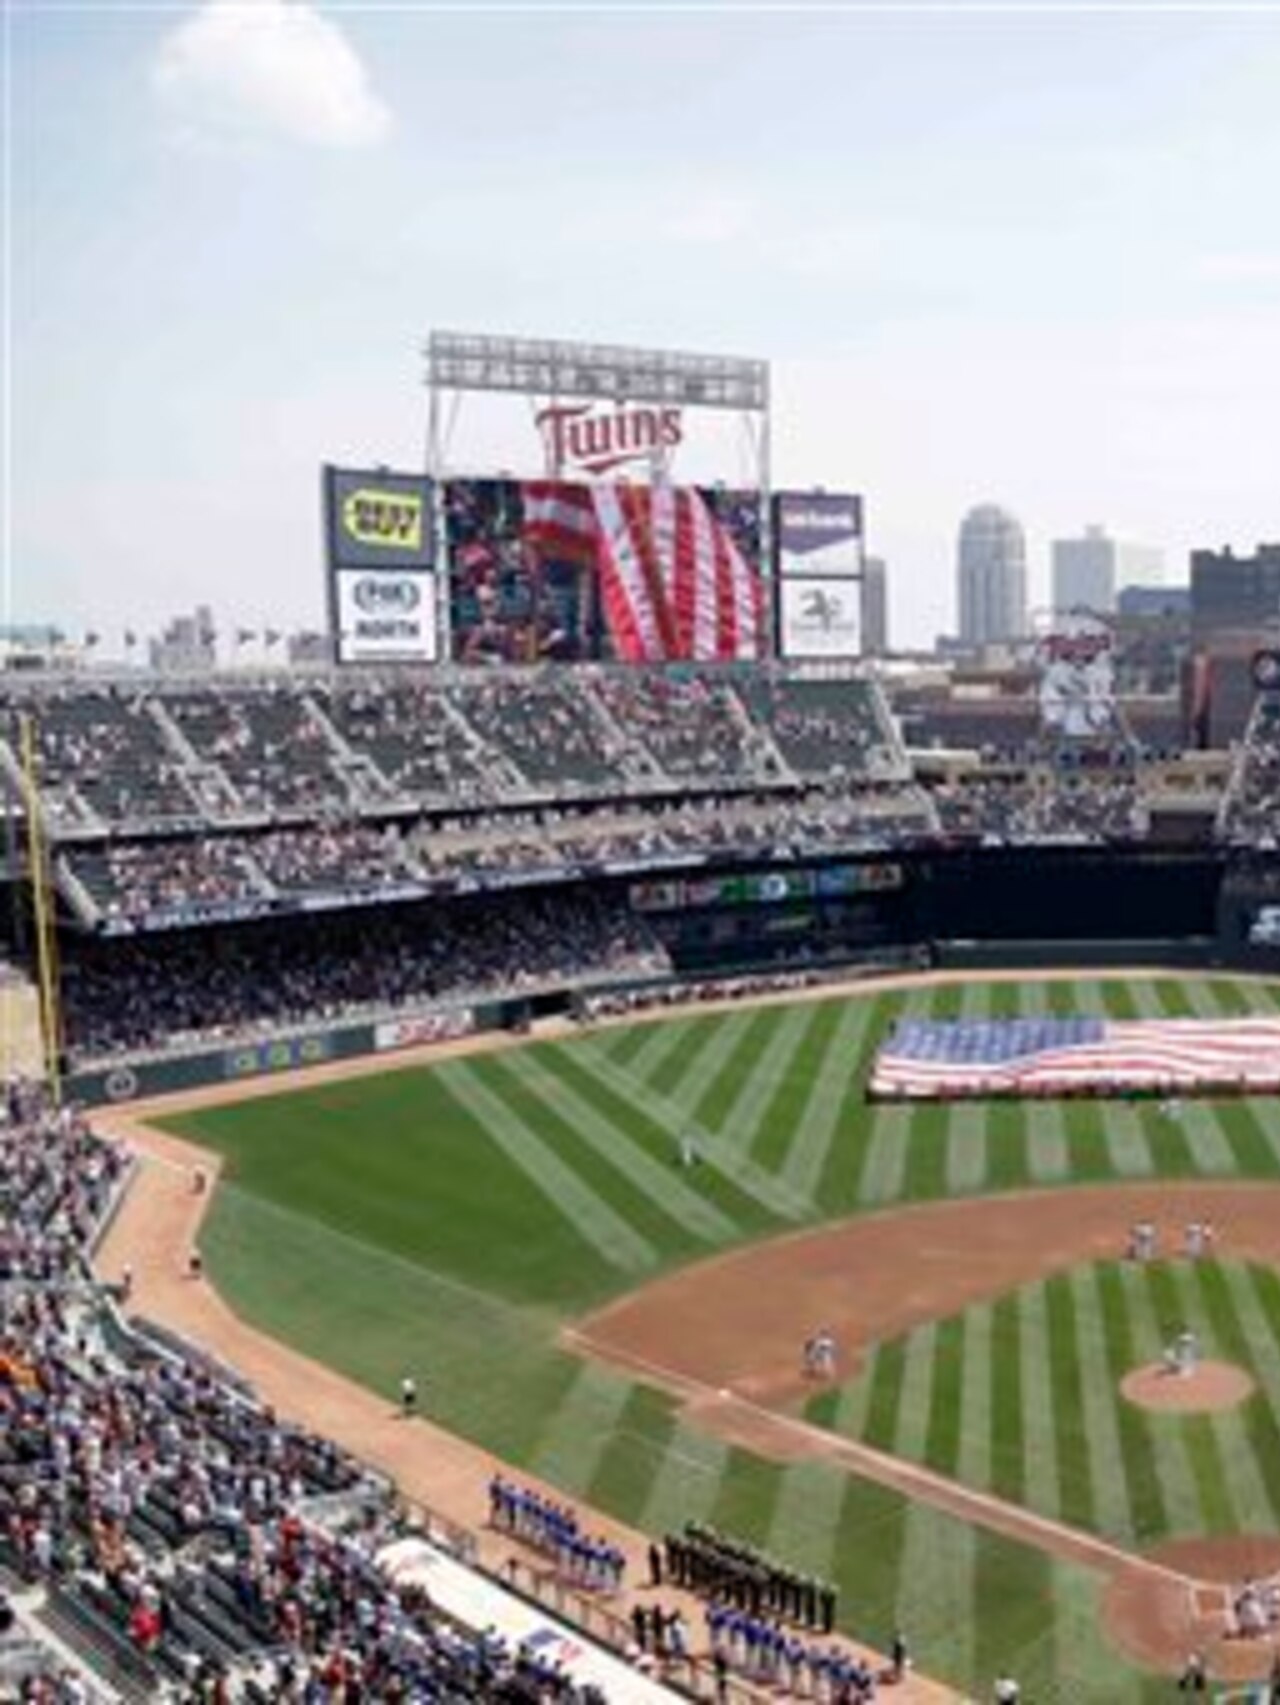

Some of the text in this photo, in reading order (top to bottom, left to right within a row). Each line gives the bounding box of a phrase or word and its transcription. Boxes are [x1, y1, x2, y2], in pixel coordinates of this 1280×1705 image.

[534, 404, 682, 467] Twins
[354, 499, 418, 518] BEST
[355, 517, 411, 539] BUY
[356, 619, 420, 640] NORTH
